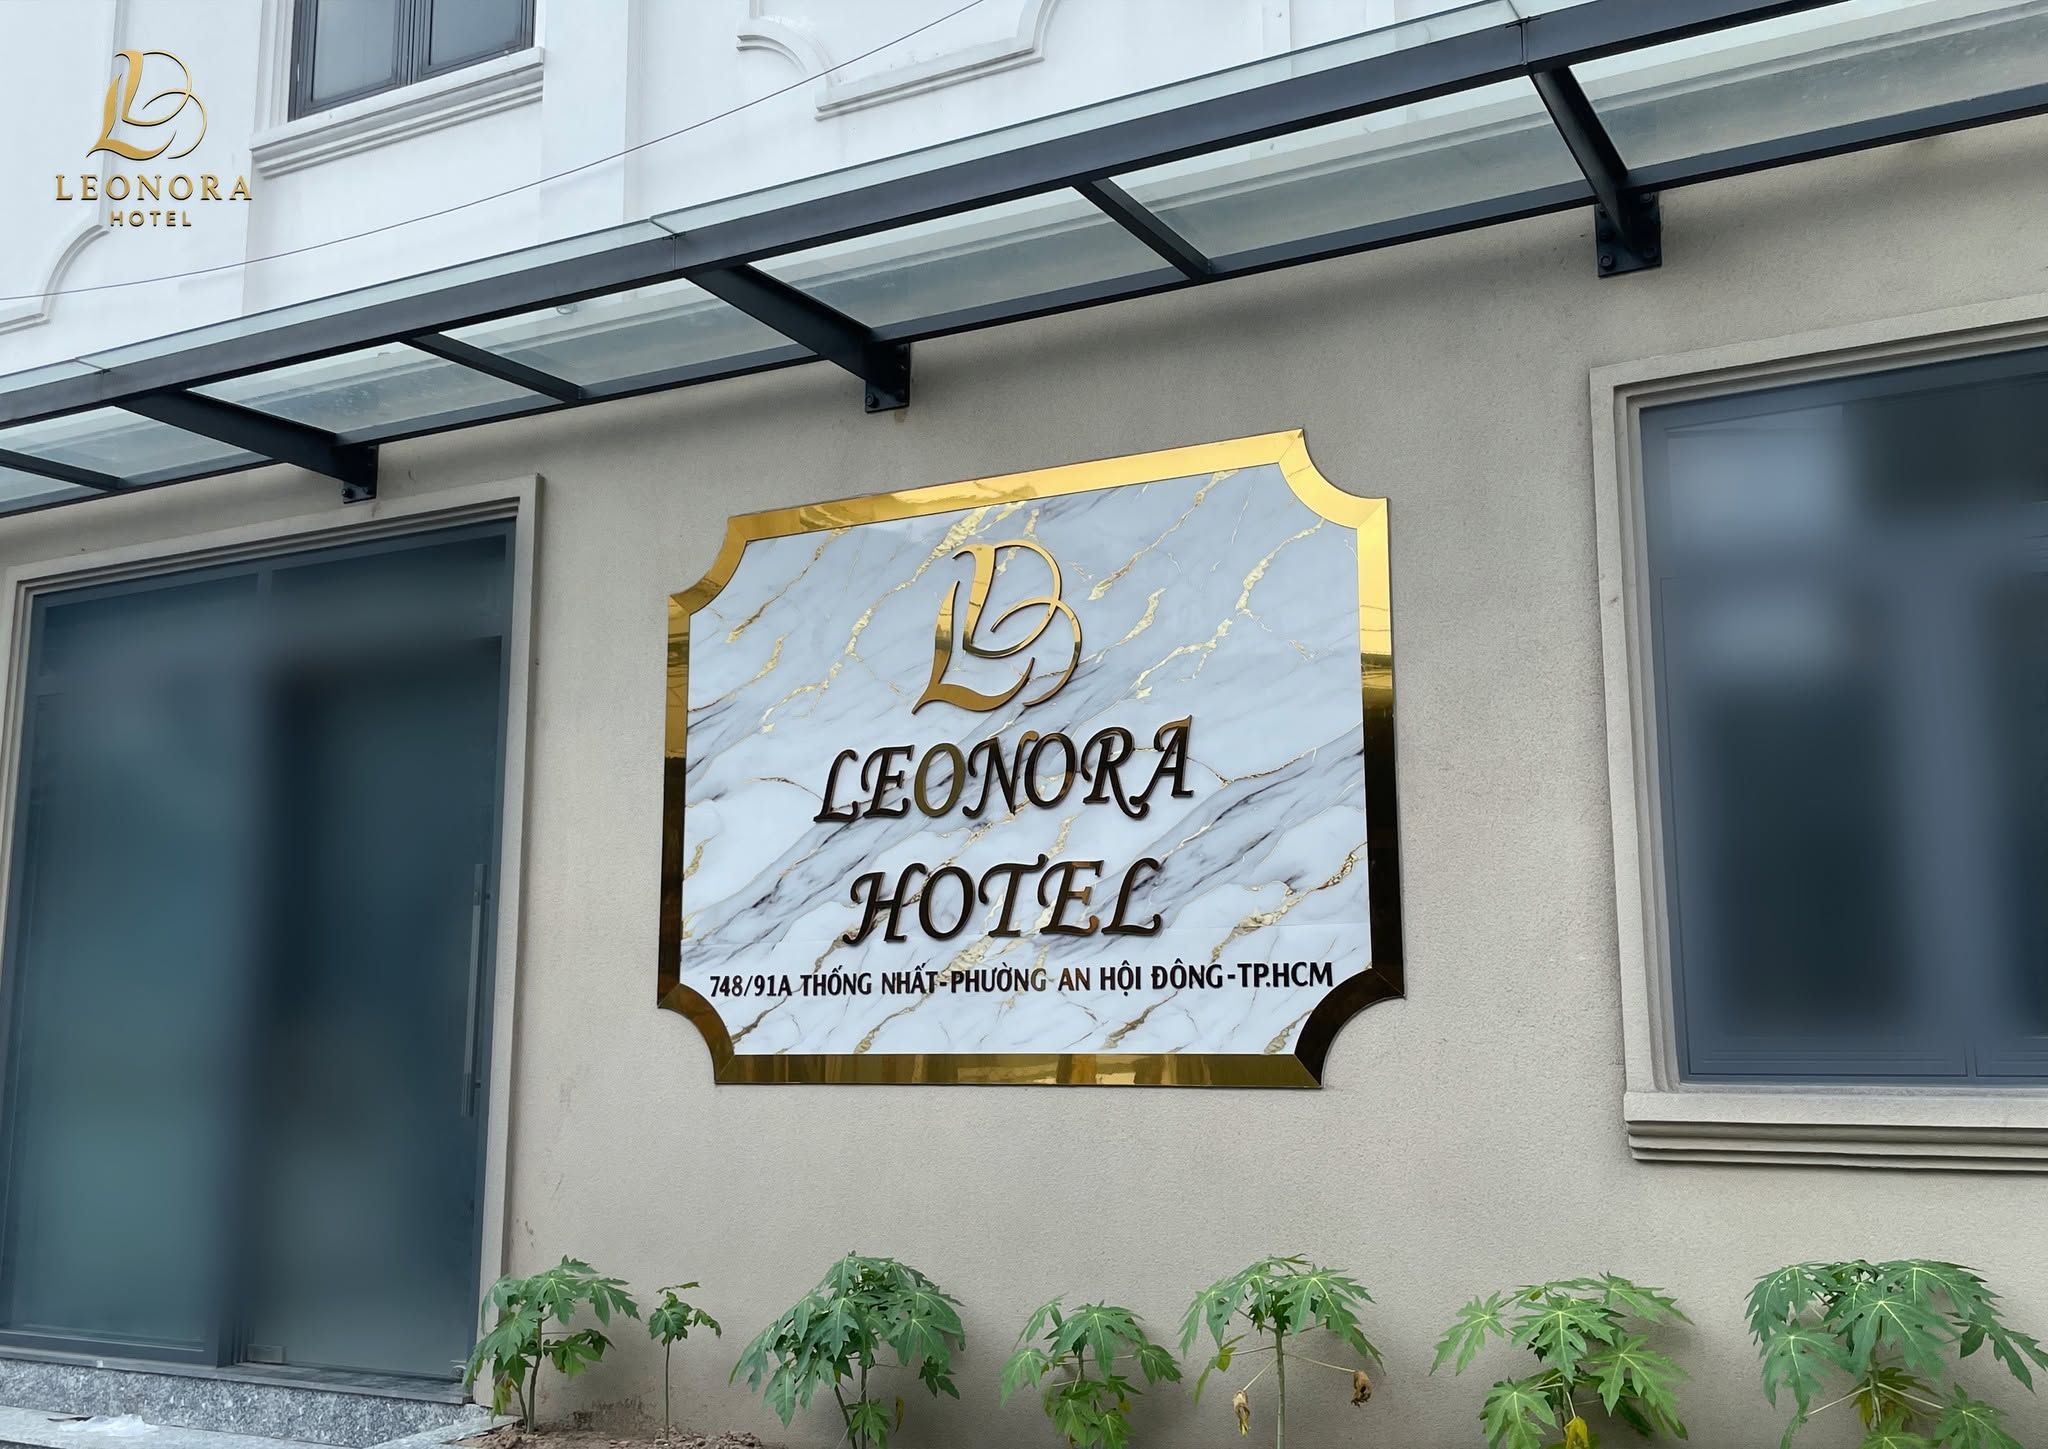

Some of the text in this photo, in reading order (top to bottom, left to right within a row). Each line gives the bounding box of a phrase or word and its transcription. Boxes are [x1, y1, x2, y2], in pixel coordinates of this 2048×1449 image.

[813, 714, 1194, 823] LEONORA
[843, 854, 1162, 947] HOTEL
[710, 975, 792, 997] 748/91A
[800, 965, 872, 996] THỐNG
[1059, 967, 1091, 991] AN
[1100, 960, 1142, 997] HỘI
